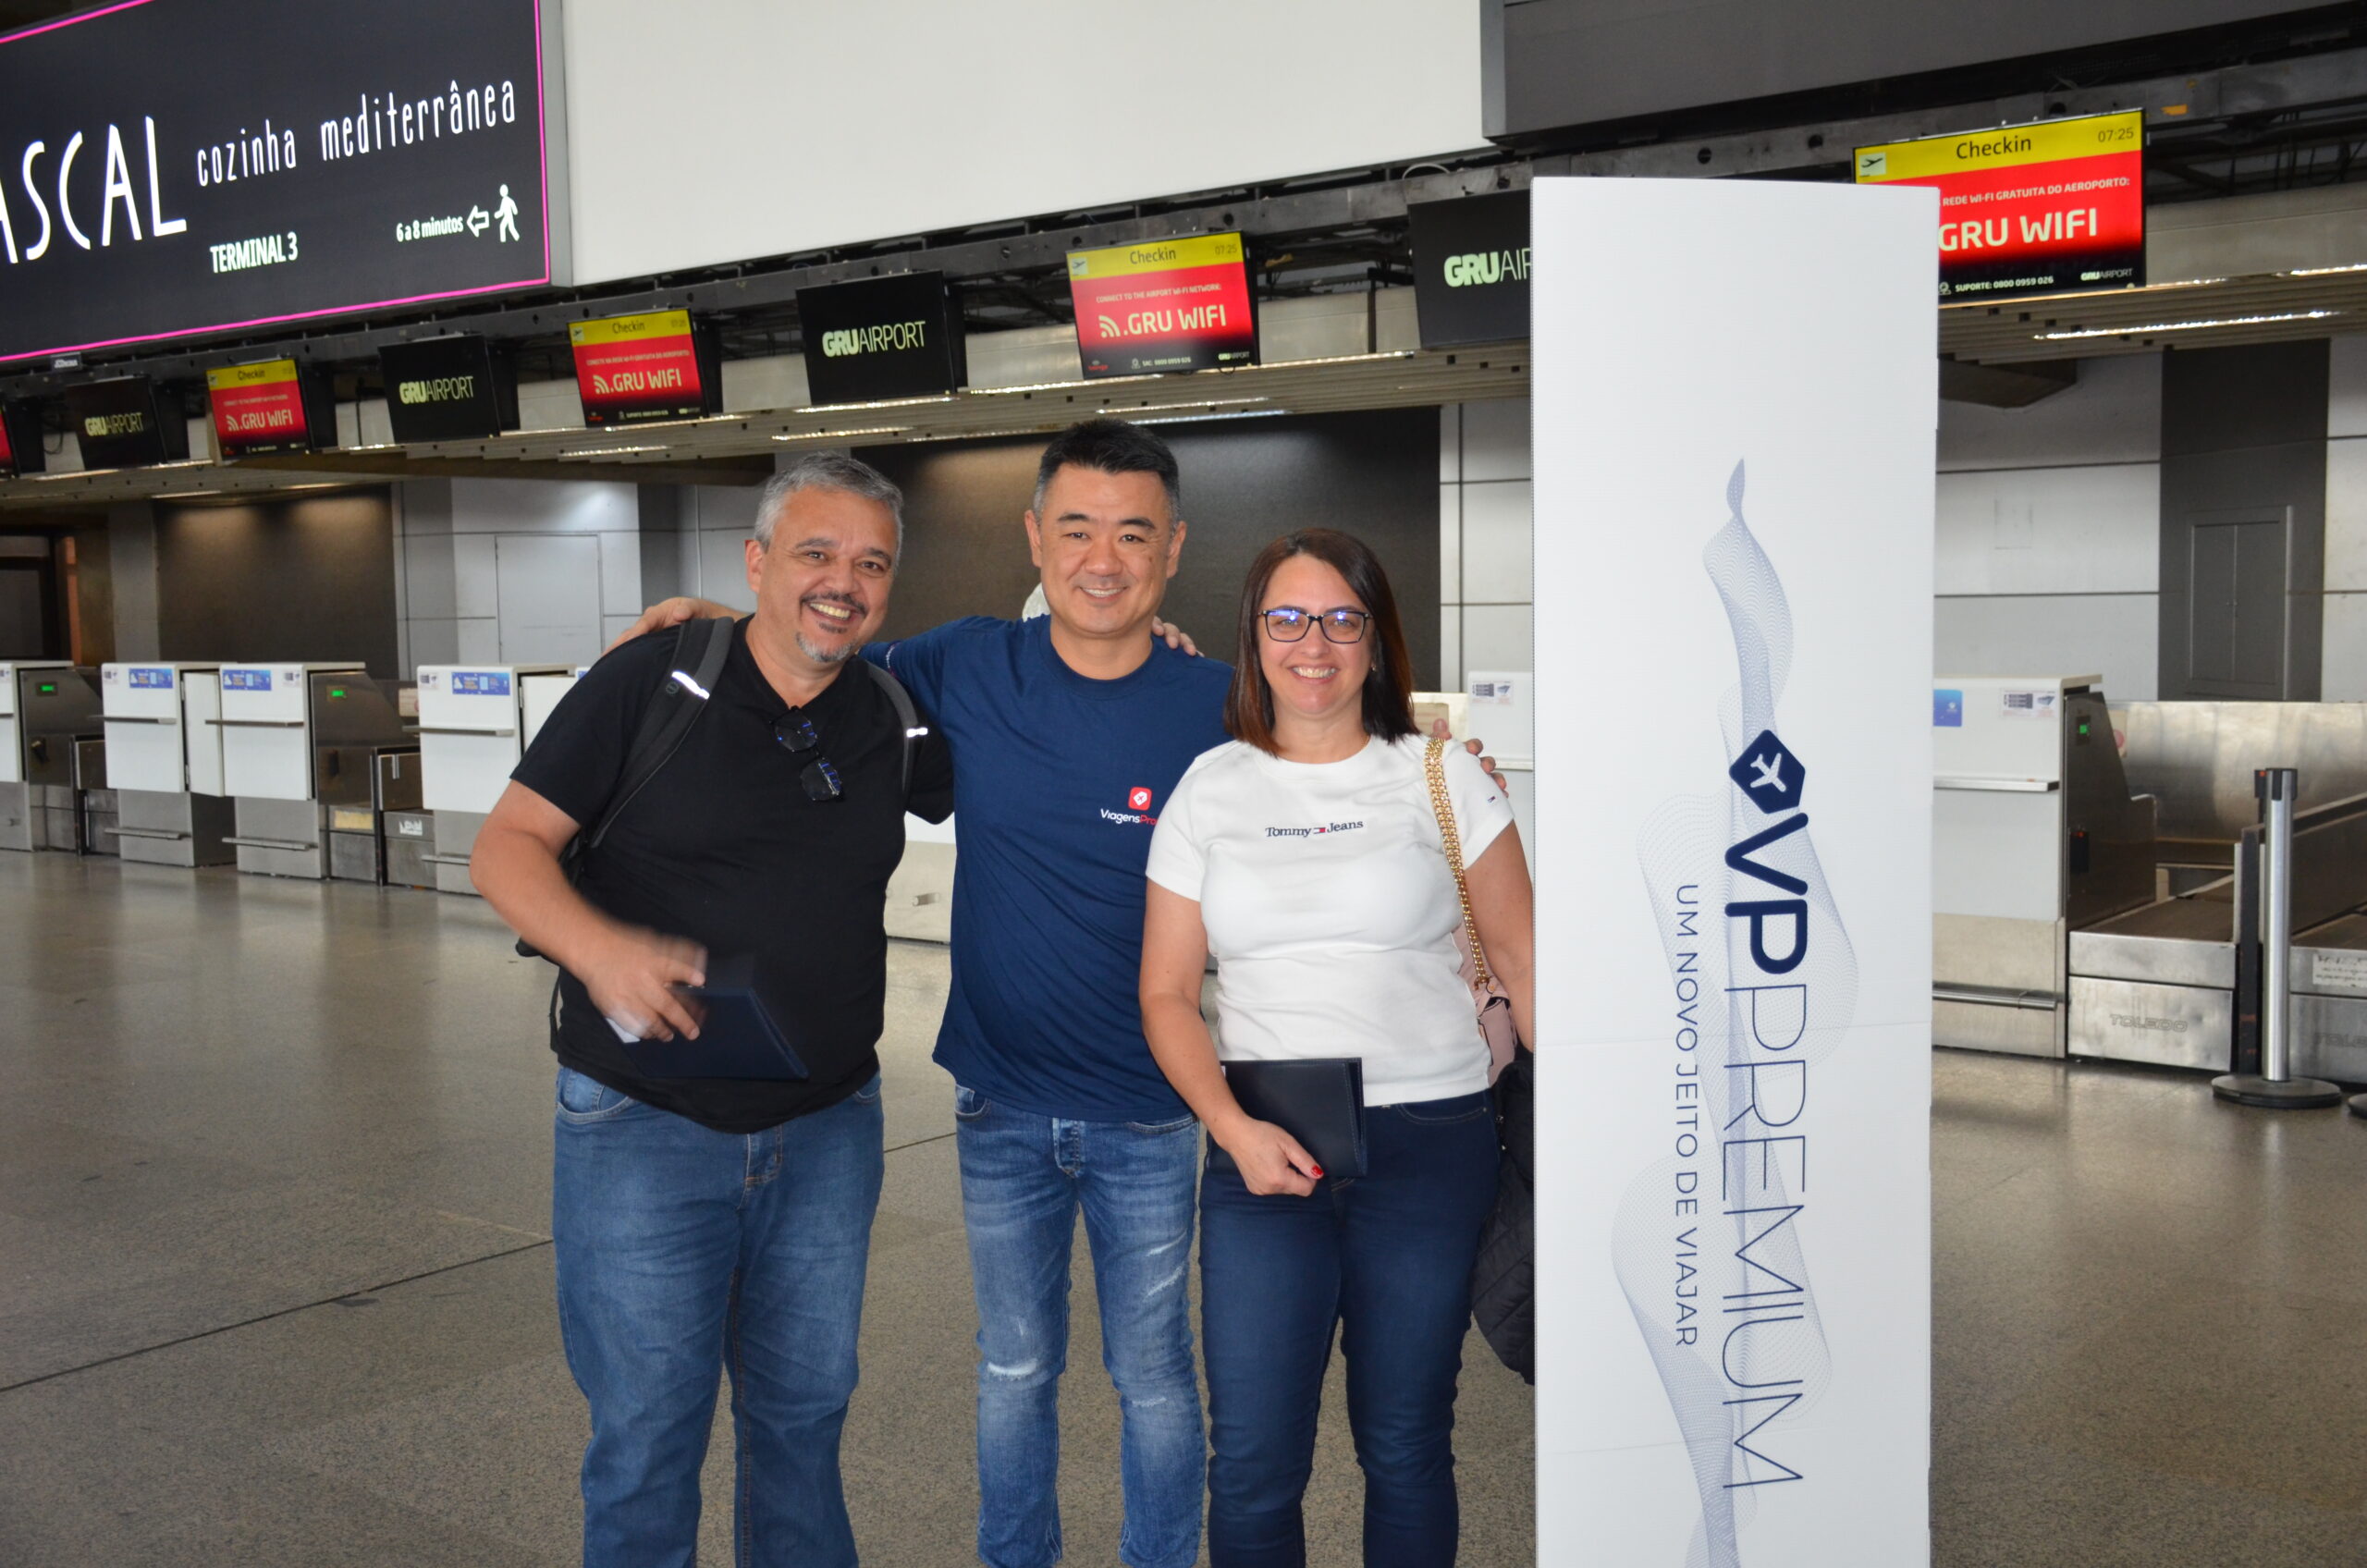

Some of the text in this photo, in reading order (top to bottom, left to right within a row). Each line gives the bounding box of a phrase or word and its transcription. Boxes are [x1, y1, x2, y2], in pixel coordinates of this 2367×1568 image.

[196, 80, 515, 187] cozinha mediterrânea
[1956, 127, 2134, 160] Checkin 07:25
[1943, 177, 2129, 206] REDE WI-FI GRATUITA DO AEROPORTO:
[396, 215, 464, 242] 6 a 8 minutos
[2019, 208, 2097, 243] WIFI
[210, 231, 299, 273] TERMINAL 3
[1130, 248, 1176, 265] Checkin
[1955, 282, 1992, 292] SUPORTE:
[1993, 280, 2015, 289] 0800
[2037, 276, 2054, 285] 026
[611, 320, 645, 335] Checkin
[1178, 304, 1227, 330] WIFI
[822, 320, 926, 358] GRUAIRPORT
[399, 375, 474, 405] GRUAIRPORT
[647, 368, 682, 390] WIFI
[266, 409, 294, 427] WIFI
[1265, 820, 1364, 839] Tommy Jeans
[2109, 1013, 2189, 1034] TOLEDO
[1675, 884, 1699, 1347] UM NOVO JEITO DE VIAJAR
